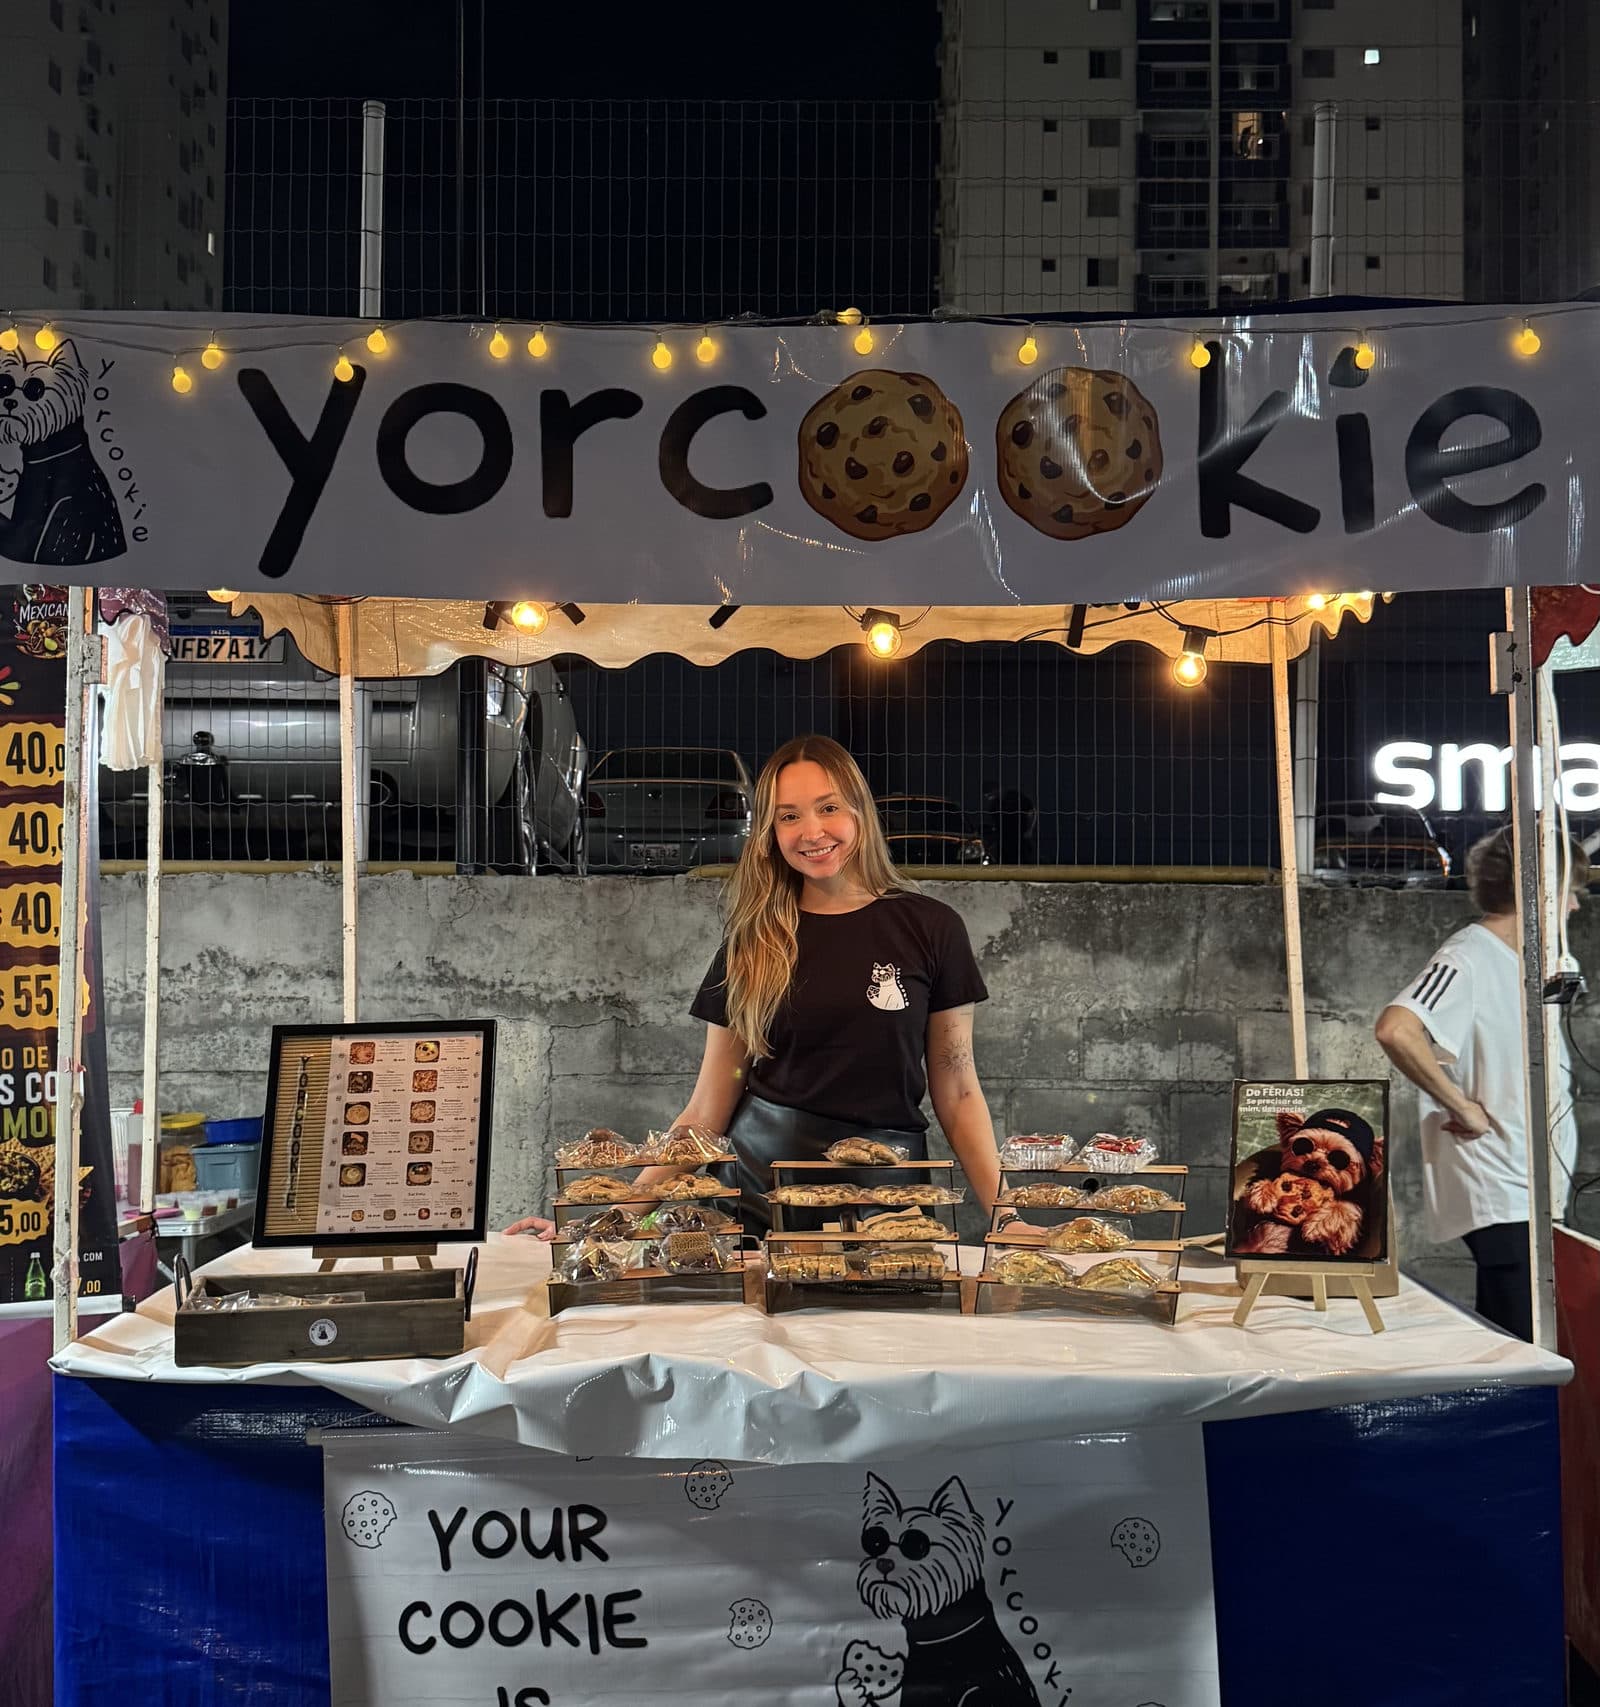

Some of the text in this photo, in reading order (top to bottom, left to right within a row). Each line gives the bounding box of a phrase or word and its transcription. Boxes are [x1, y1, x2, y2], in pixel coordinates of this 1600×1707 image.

[94, 359, 148, 542] yorcookie
[6, 731, 66, 777] 40,0
[8, 811, 64, 857] 40,
[11, 891, 59, 938] 40,
[14, 974, 59, 1020] 55,
[23, 1046, 49, 1069] DE
[25, 1071, 58, 1104] CO
[1262, 1086, 1305, 1097] FÉRIAS!
[0, 1106, 57, 1139] MO
[83, 1252, 103, 1262] COM
[428, 1504, 609, 1571] YOUR
[399, 1589, 648, 1655] COOKIE
